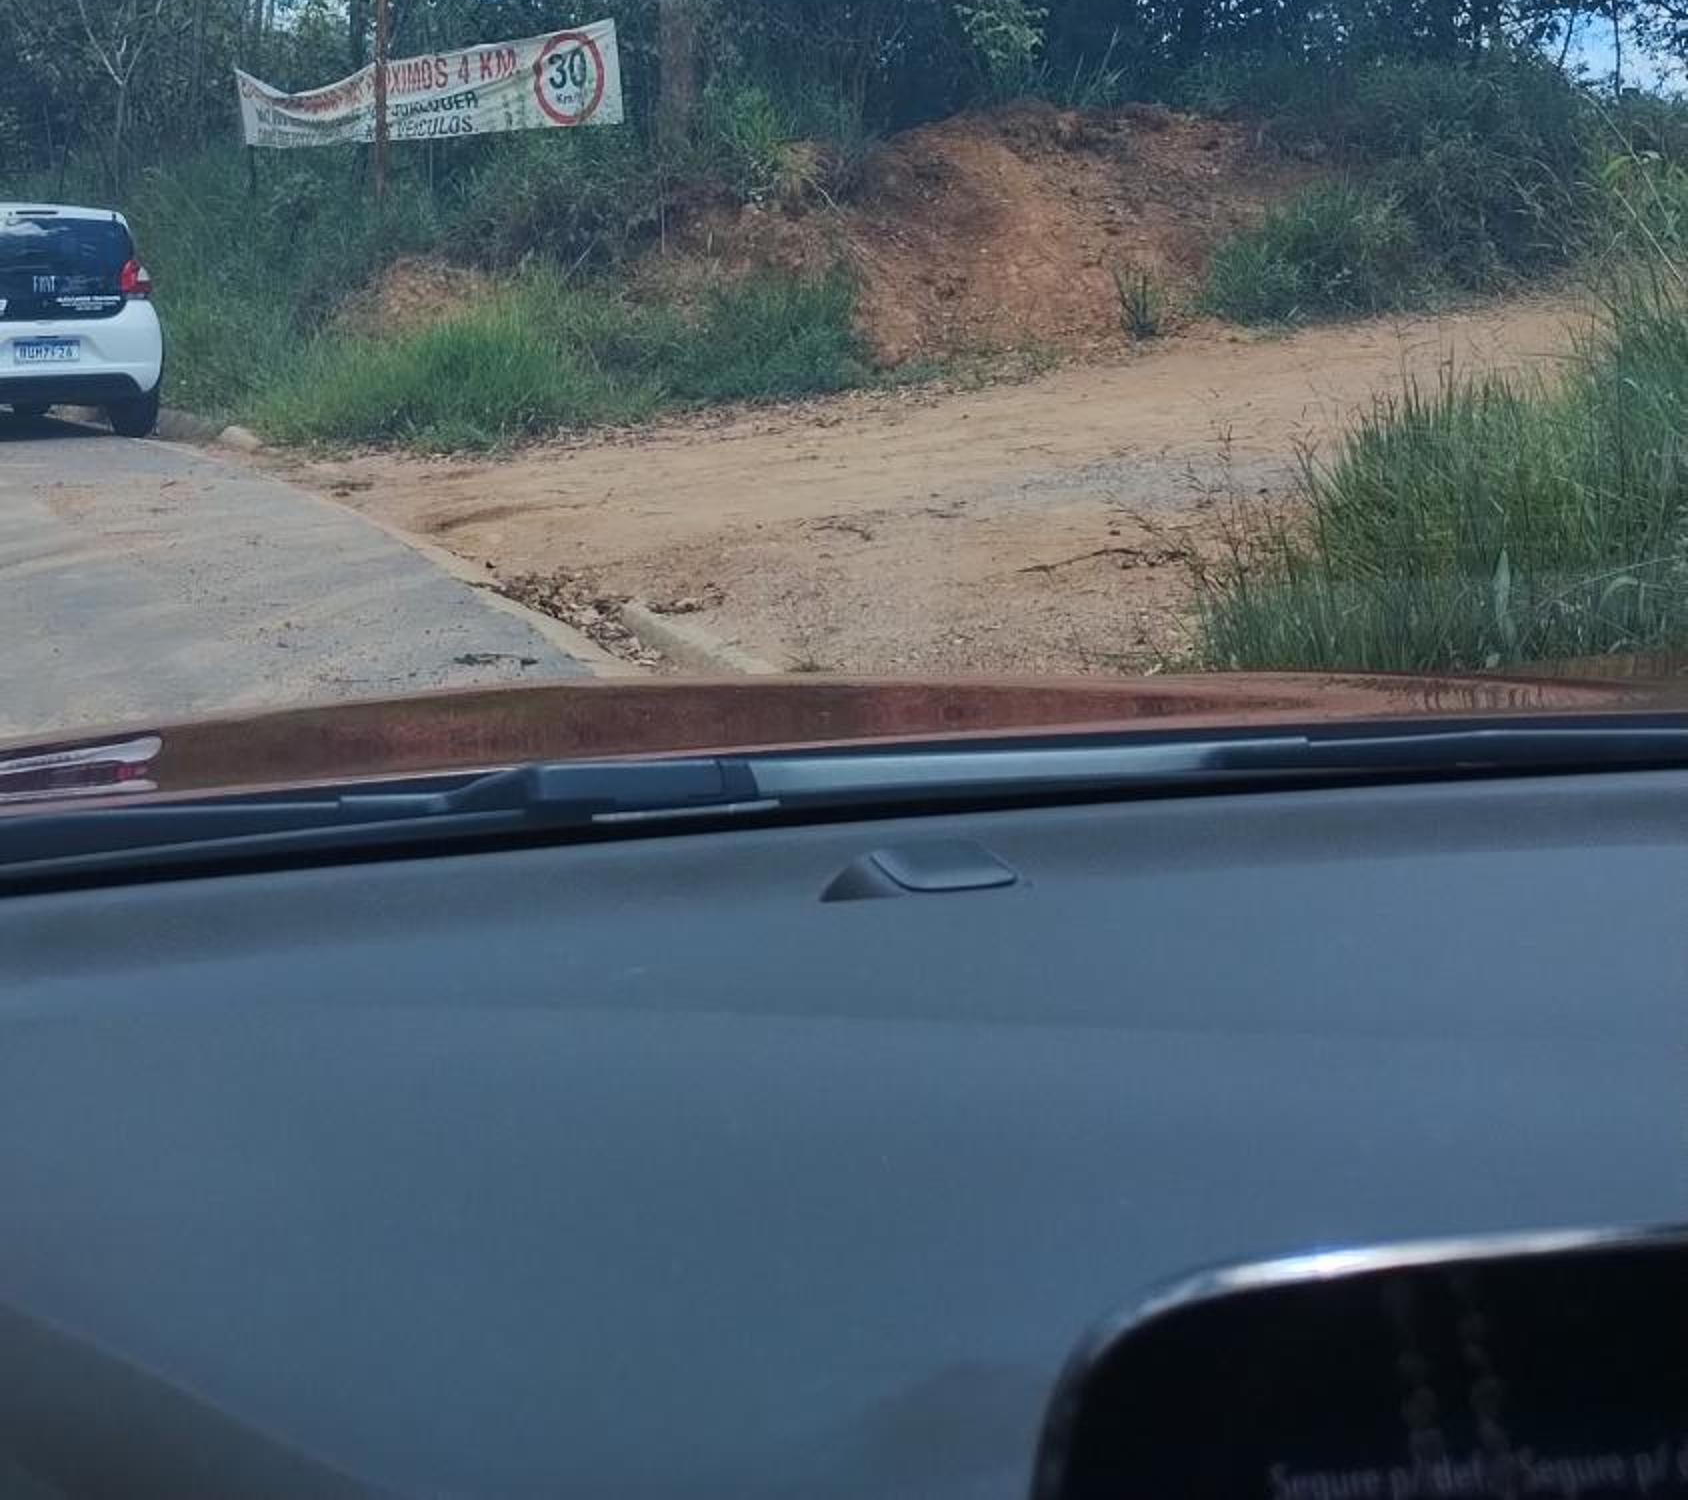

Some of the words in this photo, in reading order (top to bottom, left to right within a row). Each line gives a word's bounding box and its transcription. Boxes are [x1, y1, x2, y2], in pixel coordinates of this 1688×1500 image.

[457, 54, 470, 85] 4
[549, 47, 587, 90] 30
[33, 276, 56, 293] FIAT
